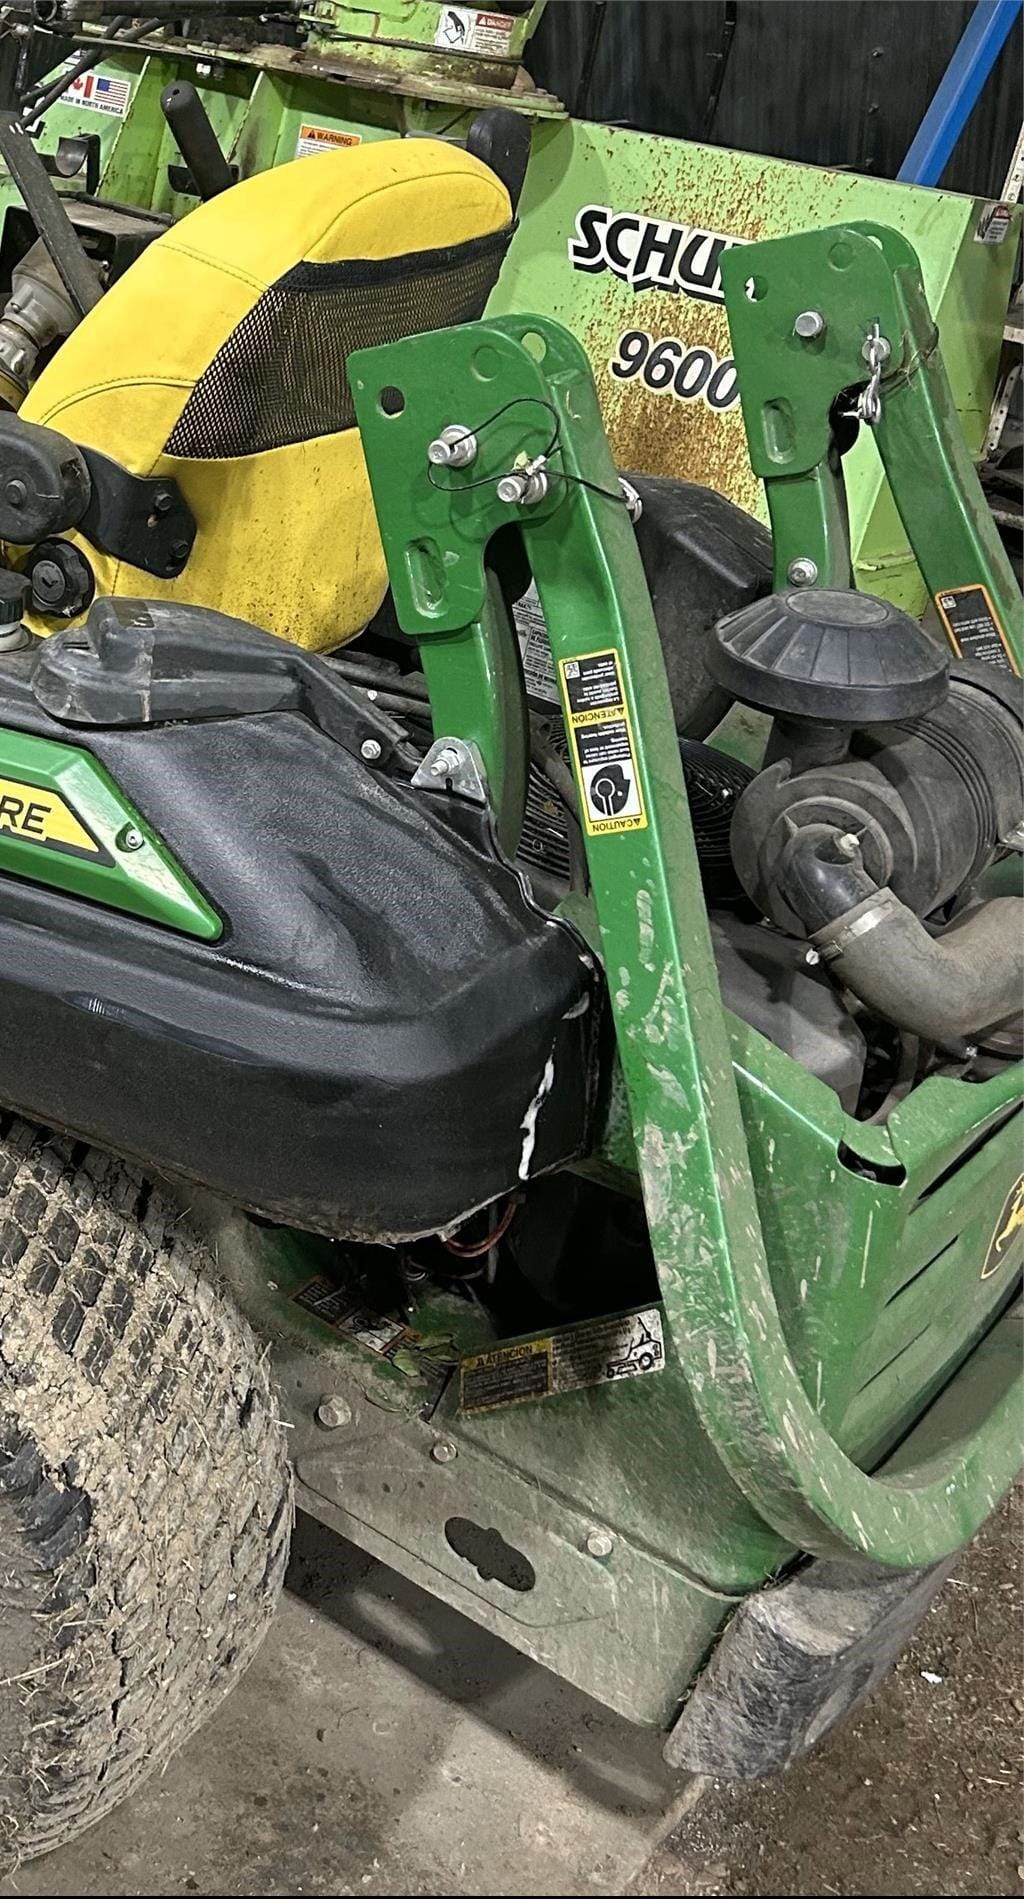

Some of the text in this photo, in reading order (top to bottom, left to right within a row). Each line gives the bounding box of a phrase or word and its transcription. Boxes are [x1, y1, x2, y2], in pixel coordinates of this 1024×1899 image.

[82, 100, 98, 109] NORTH
[99, 103, 123, 114] AMERICA
[317, 132, 353, 146] WARNING
[572, 209, 734, 300] SCHU
[611, 331, 740, 408] 9600
[592, 818, 634, 832] CAUTION
